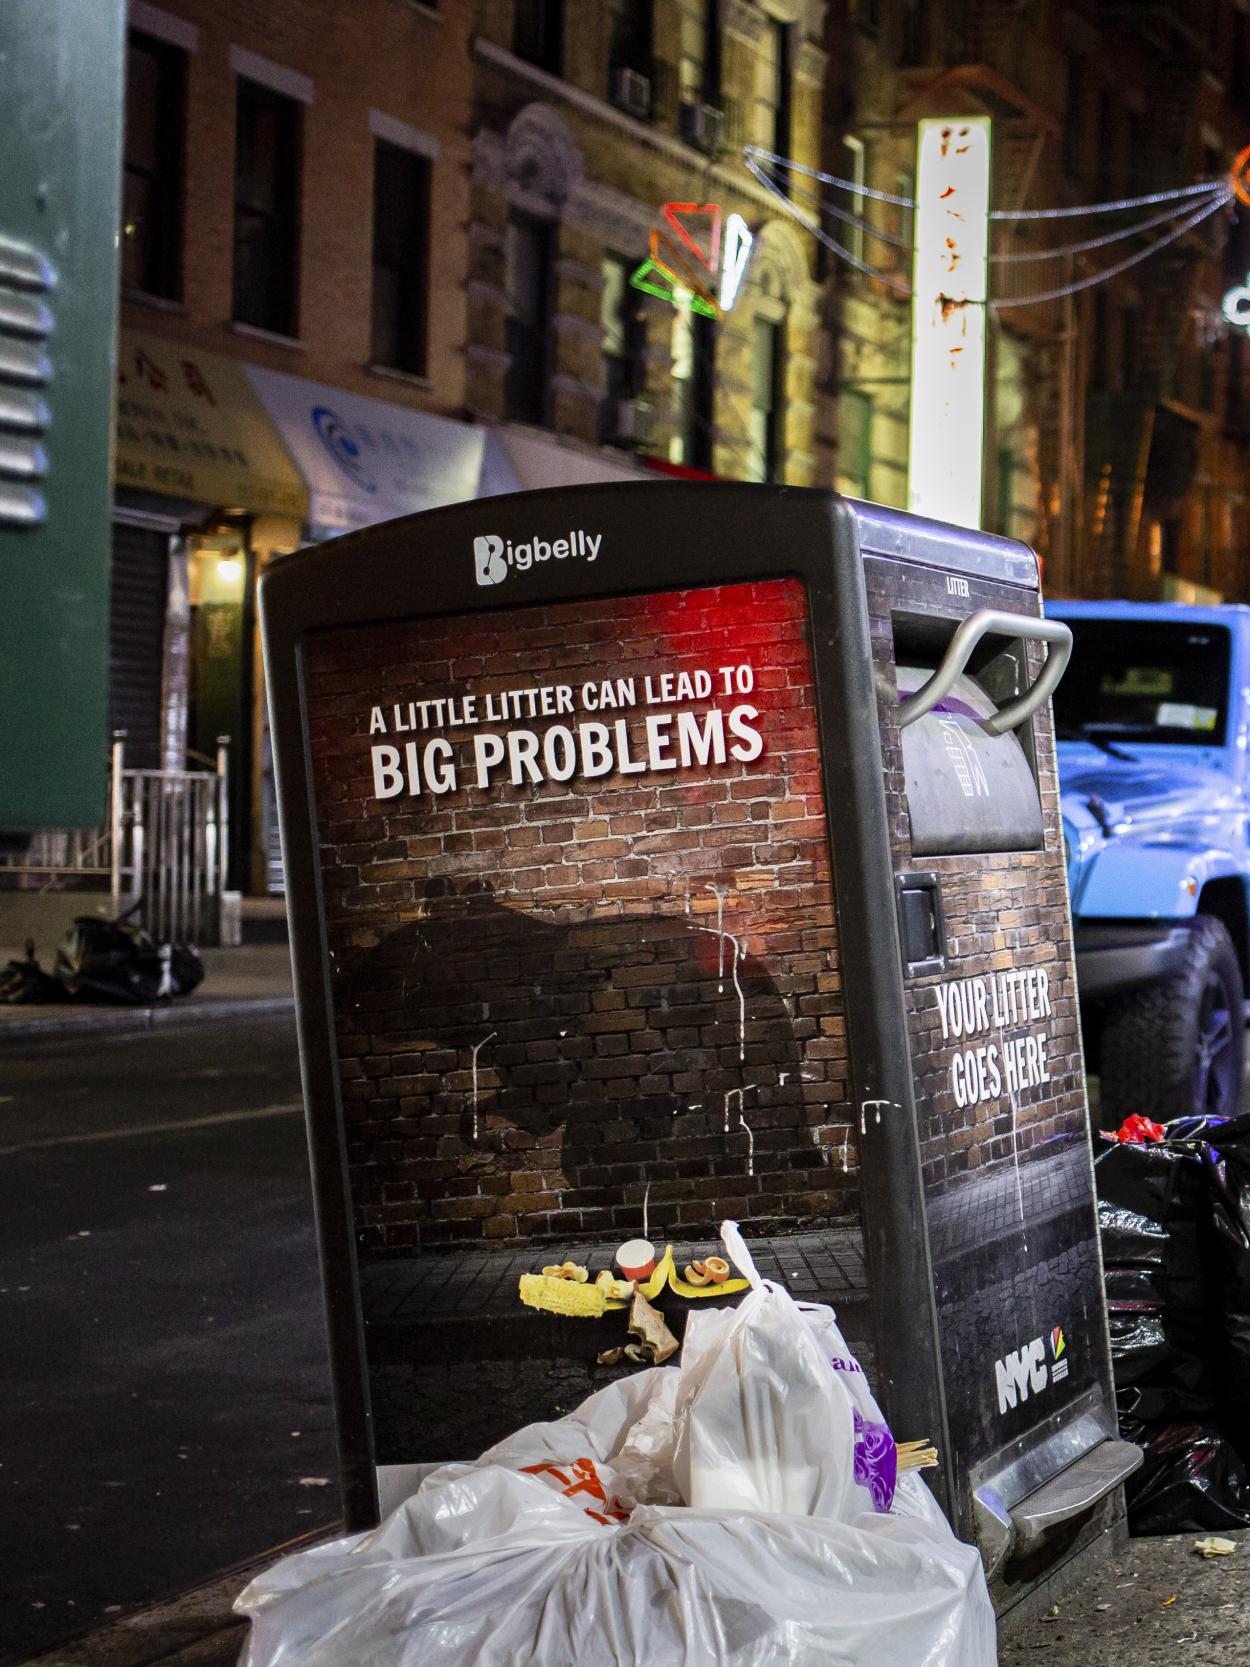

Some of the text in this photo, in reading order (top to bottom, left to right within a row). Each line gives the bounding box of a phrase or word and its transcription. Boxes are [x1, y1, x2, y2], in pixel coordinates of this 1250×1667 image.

[473, 530, 602, 586] Bigbelly
[946, 576, 970, 598] LITTER
[370, 664, 754, 735] A LITTLE LITTER CAN LEAD TO
[371, 704, 764, 800] BIG PROBLEMS
[935, 968, 1052, 1039] YOUR LITTER
[952, 1032, 1051, 1108] GOES HERE
[995, 1335, 1048, 1415] NYC
